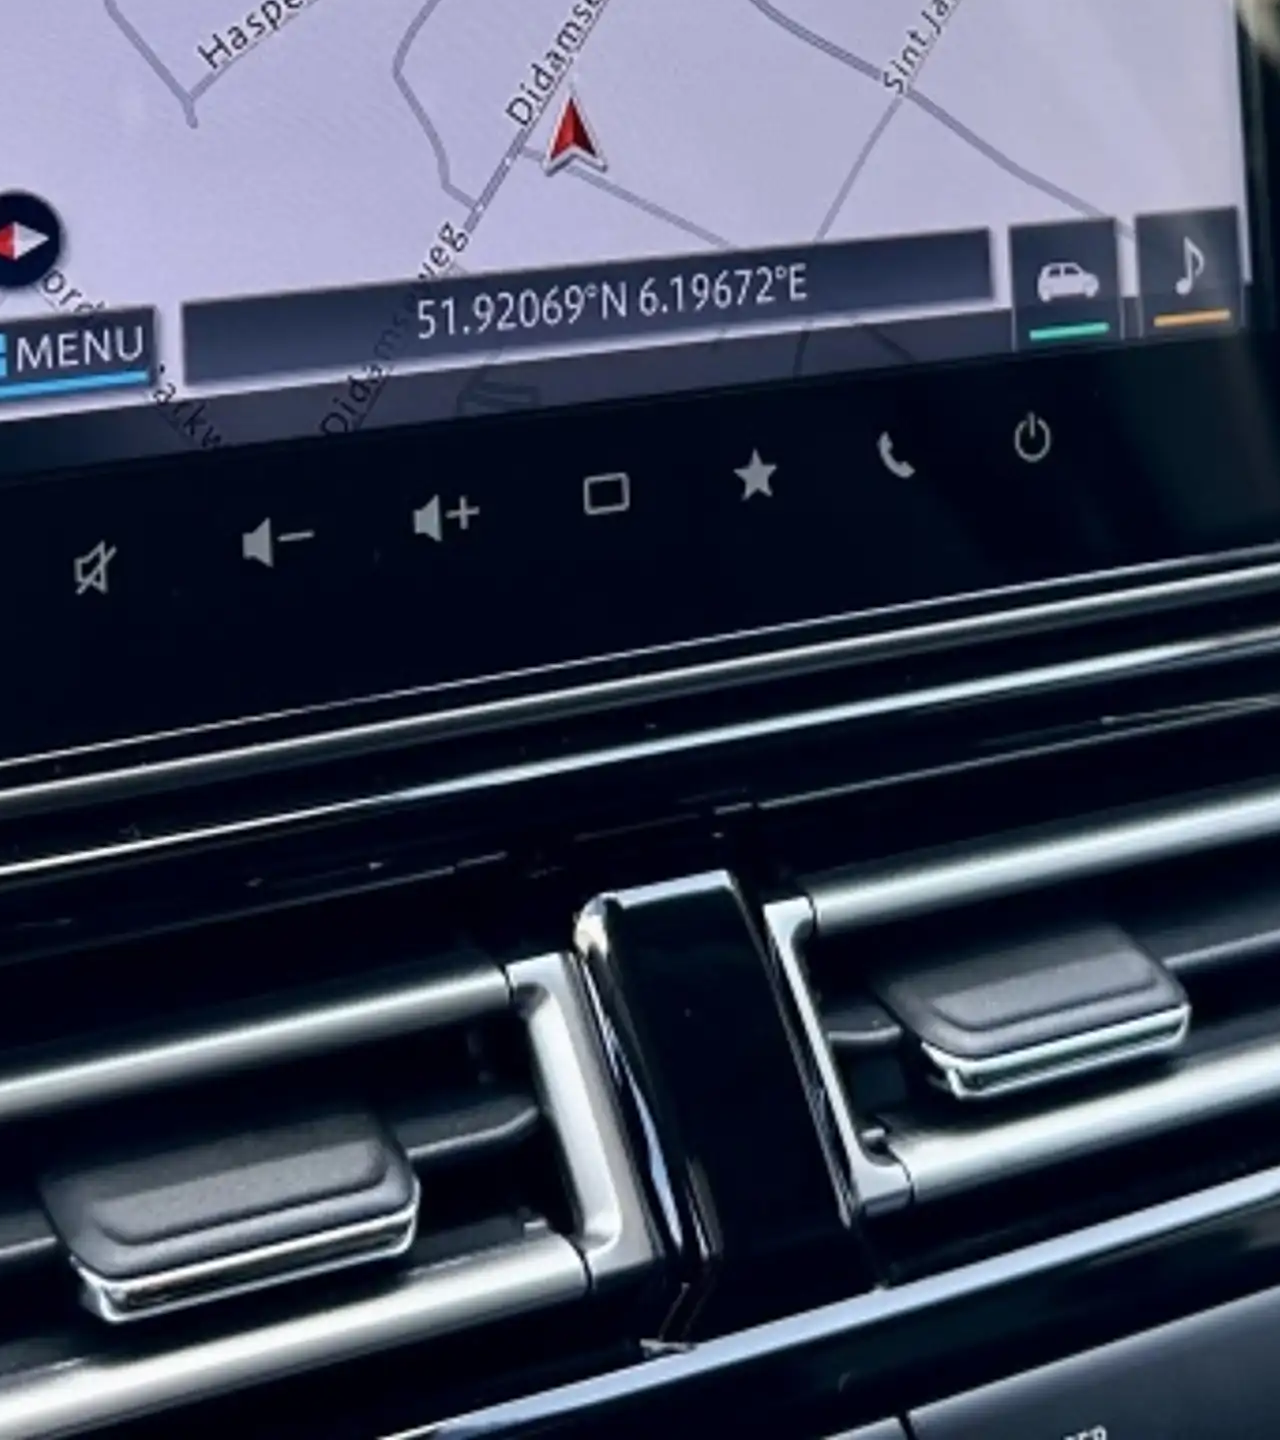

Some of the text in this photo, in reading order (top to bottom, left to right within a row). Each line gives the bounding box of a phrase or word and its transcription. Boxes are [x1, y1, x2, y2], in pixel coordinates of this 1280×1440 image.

[883, 29, 928, 94] Sint
[417, 262, 808, 340] 51.92069°N 6.19672°E
[16, 324, 144, 374] MENU
